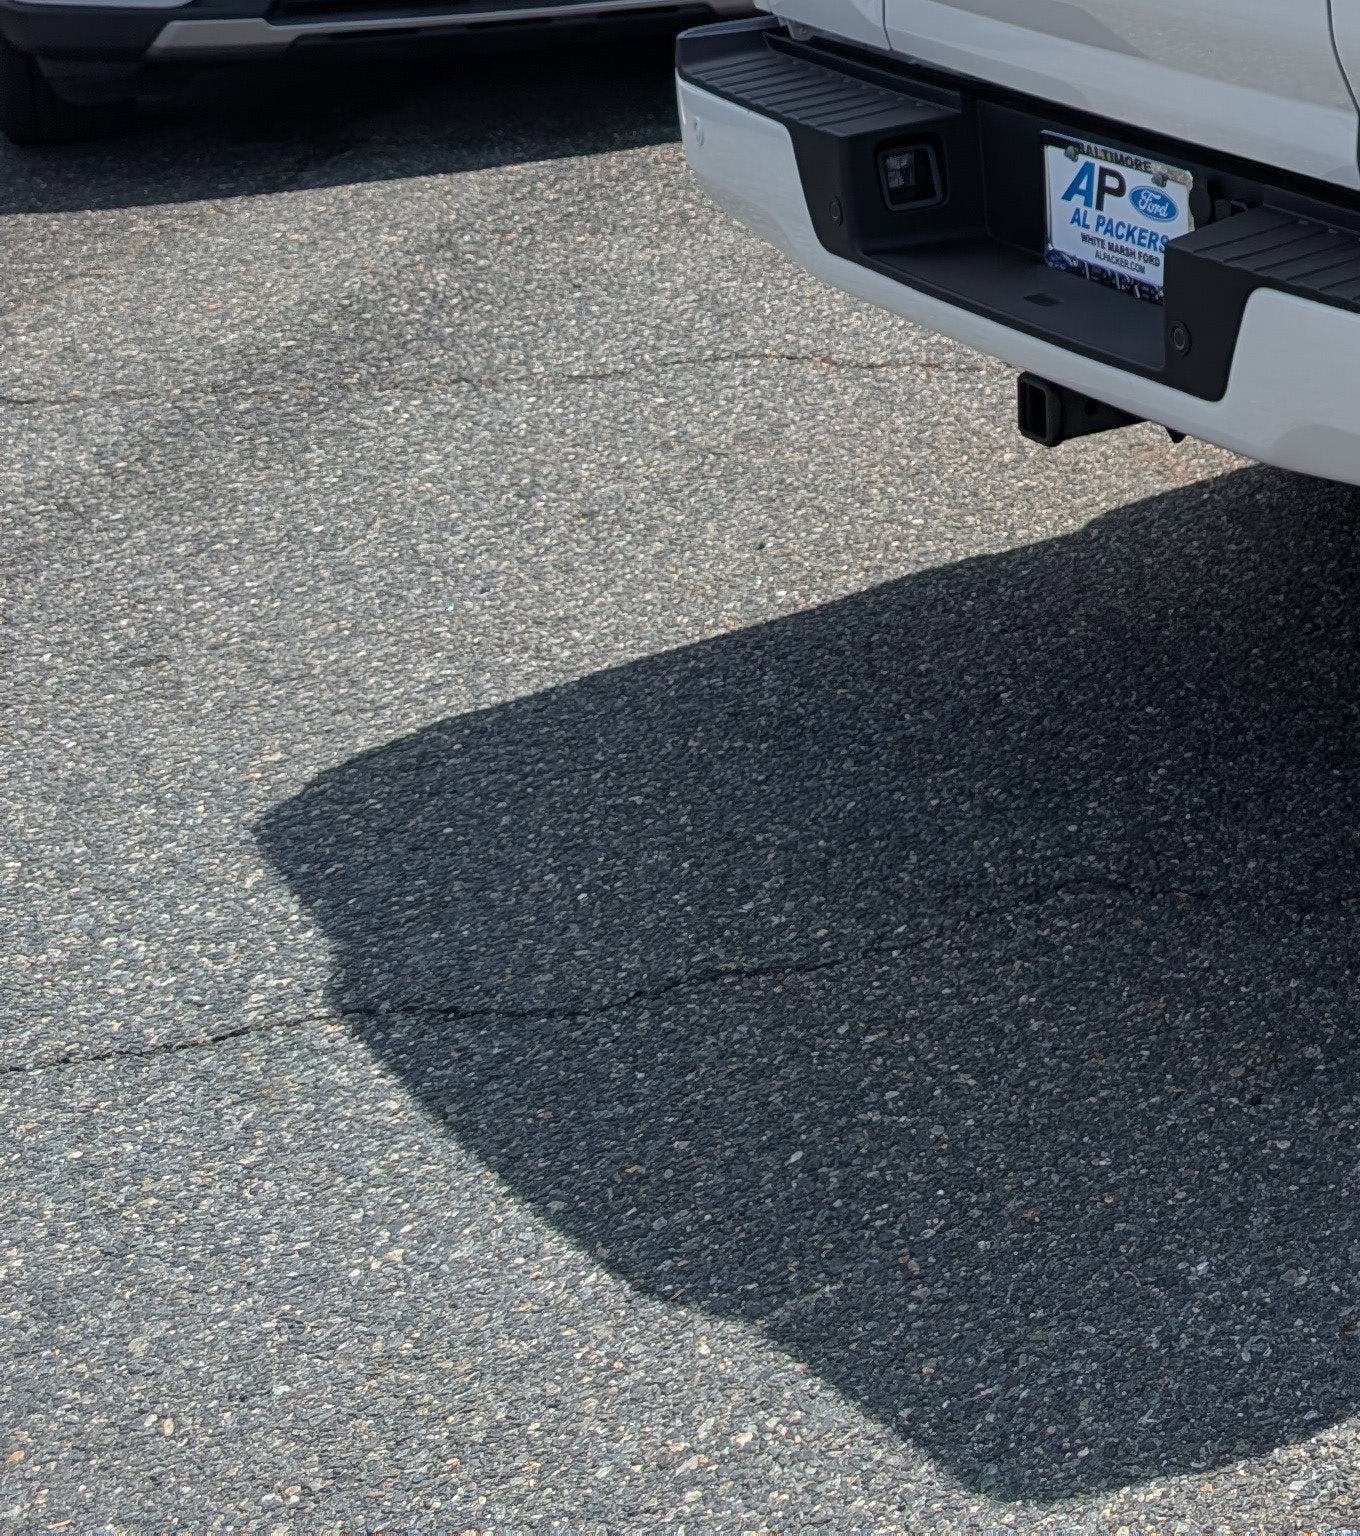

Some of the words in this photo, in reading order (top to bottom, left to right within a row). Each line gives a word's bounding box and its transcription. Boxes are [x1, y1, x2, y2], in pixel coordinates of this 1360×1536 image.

[1077, 142, 1151, 172] BALTIMORE
[1061, 160, 1127, 212] AP
[1070, 207, 1090, 229] AL
[1095, 215, 1170, 253] PACKERS
[1081, 232, 1106, 250] WHITE
[1107, 242, 1136, 259] MARSH
[1138, 252, 1161, 267] FORD
[1095, 249, 1146, 274] ALPACKER.COM
